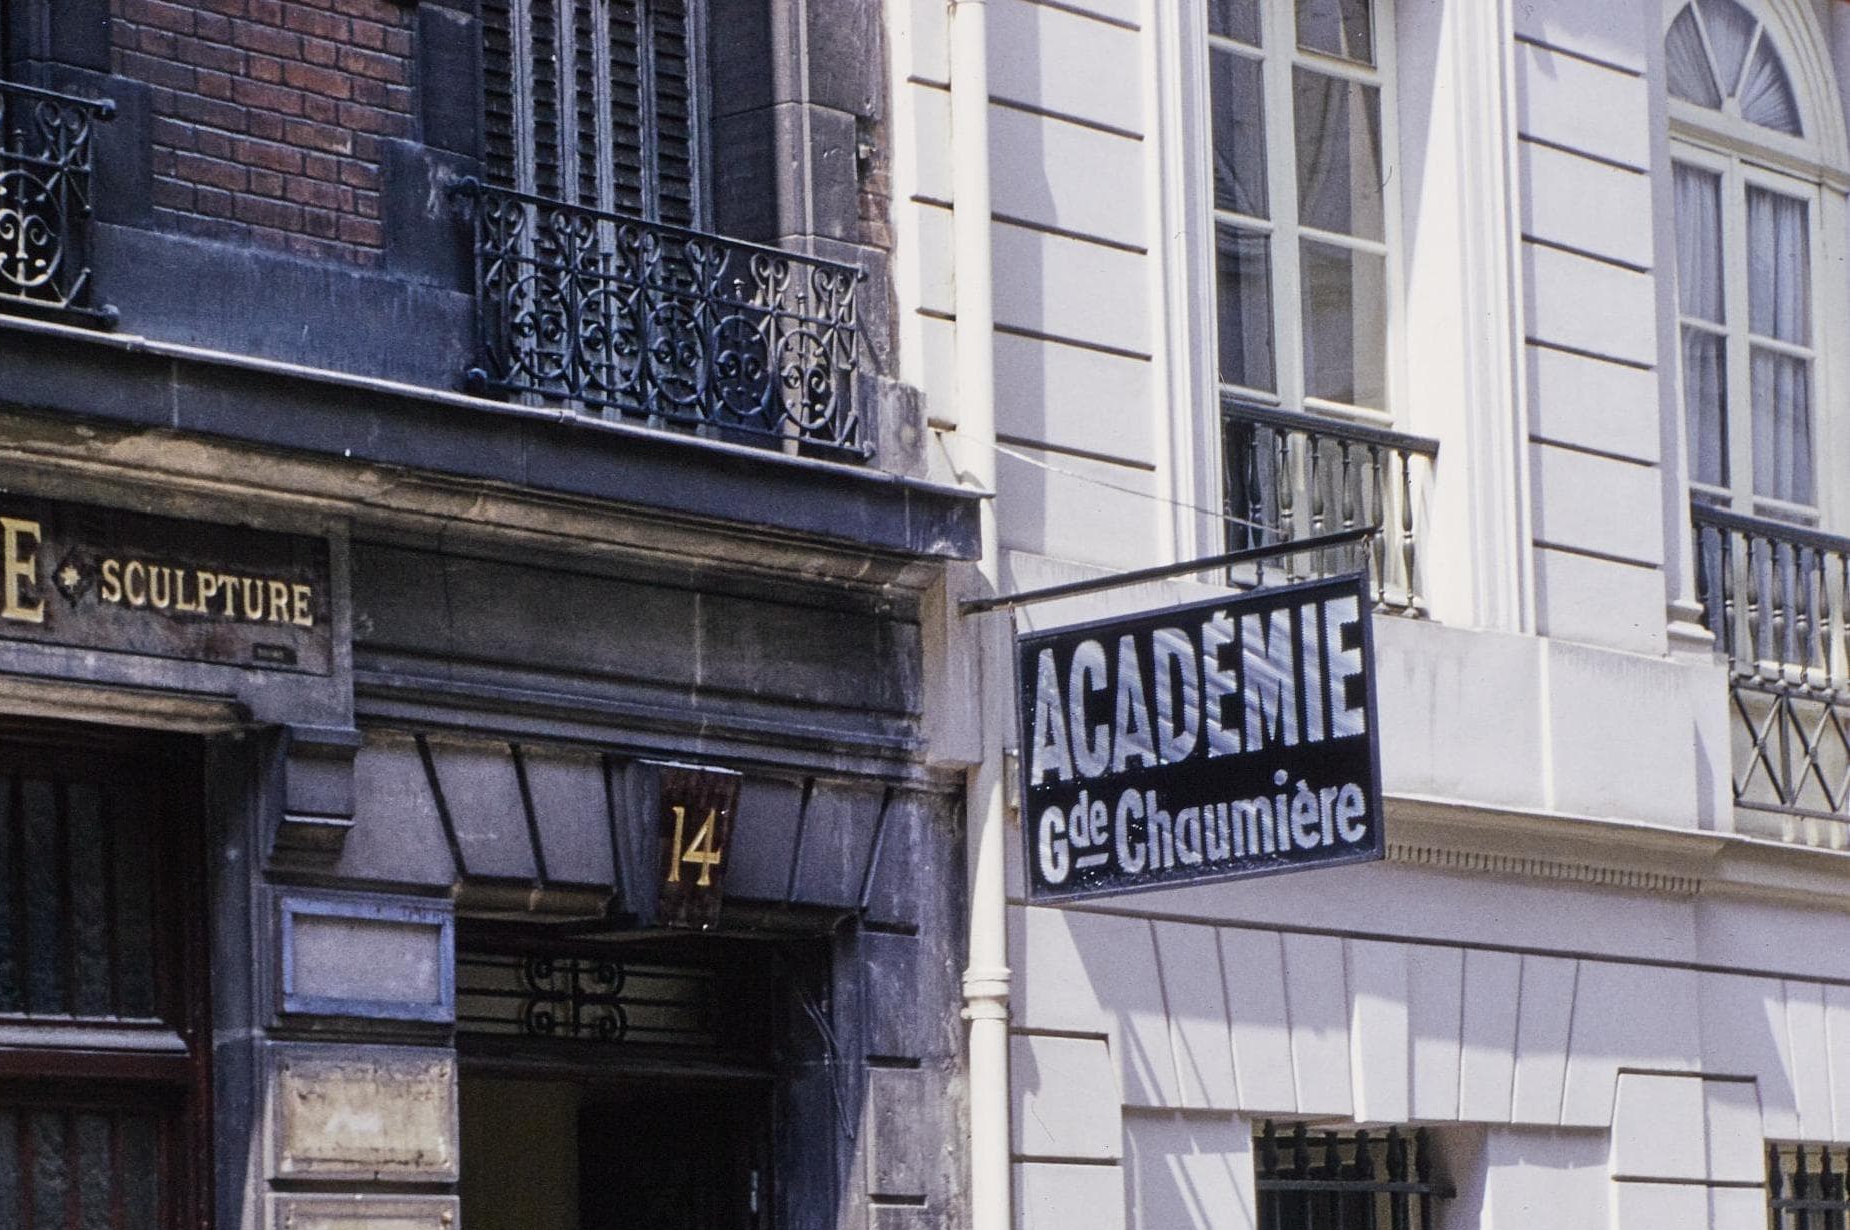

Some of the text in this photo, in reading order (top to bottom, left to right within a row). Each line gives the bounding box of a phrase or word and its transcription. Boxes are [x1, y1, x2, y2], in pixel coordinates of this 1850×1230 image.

[101, 559, 314, 627] SCULPTURE
[1030, 595, 1366, 786] ACADÉMIE
[667, 806, 721, 886] 14
[1115, 769, 1367, 874] Chaumière
